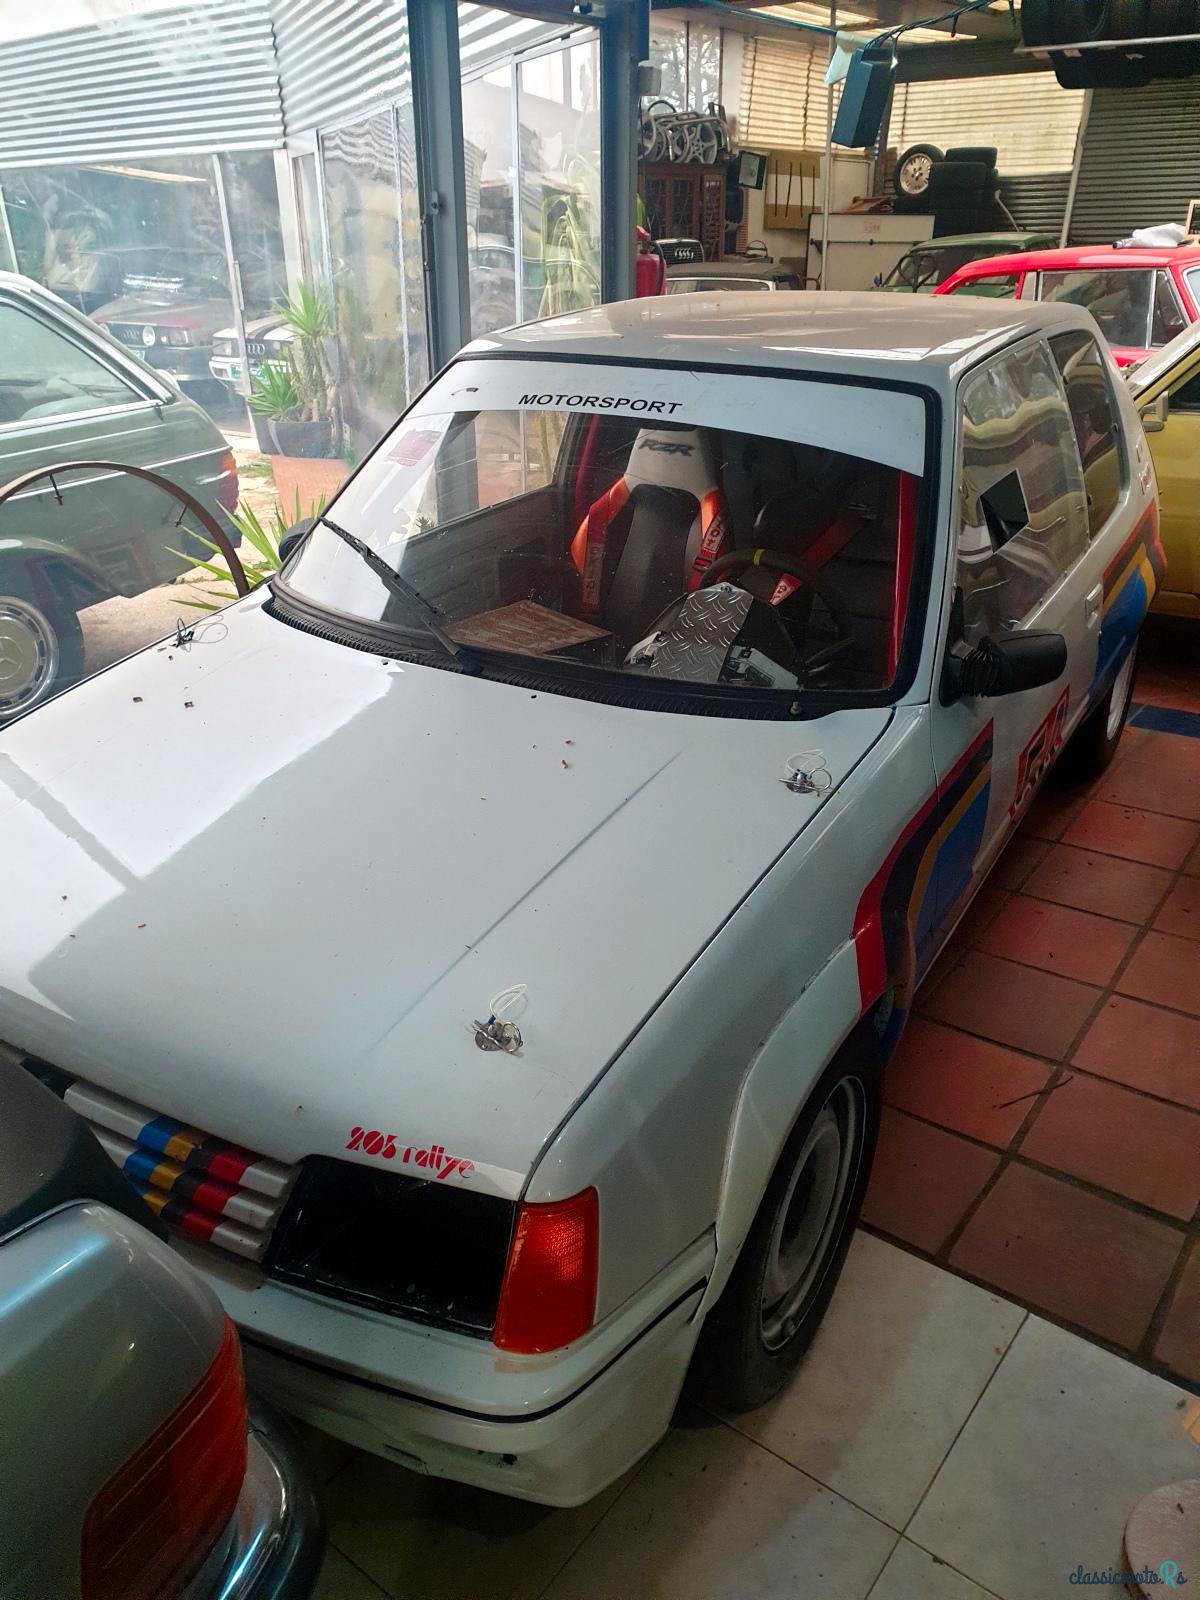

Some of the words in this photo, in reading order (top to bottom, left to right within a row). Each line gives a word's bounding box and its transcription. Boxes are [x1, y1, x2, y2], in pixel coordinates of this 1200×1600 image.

[518, 394, 683, 414] MOTORSPORT
[345, 1126, 398, 1159] 205
[402, 1145, 476, 1179] rallye
